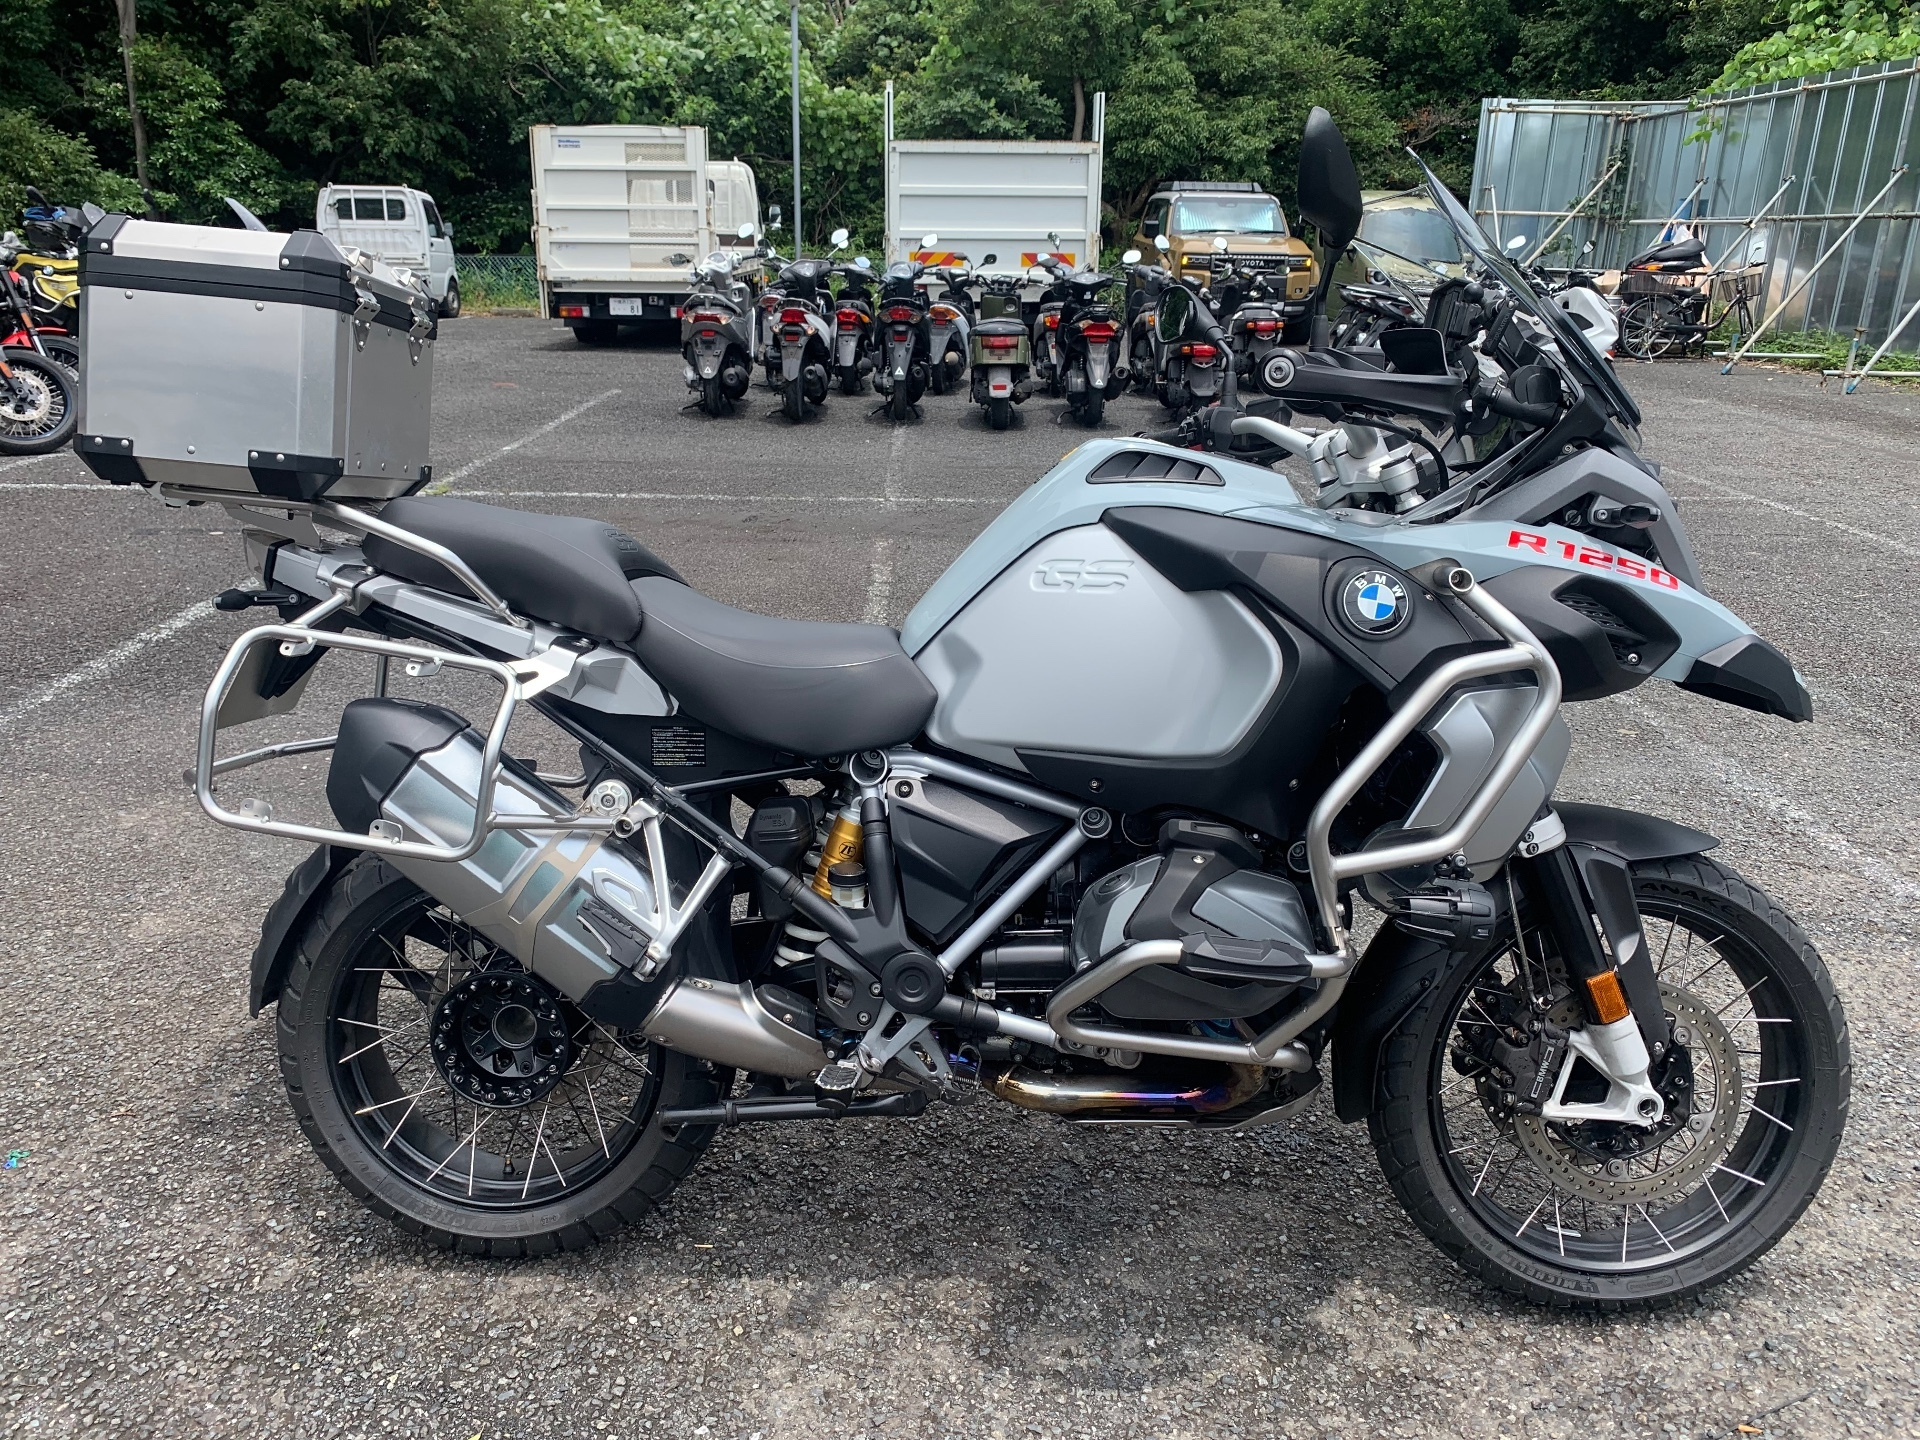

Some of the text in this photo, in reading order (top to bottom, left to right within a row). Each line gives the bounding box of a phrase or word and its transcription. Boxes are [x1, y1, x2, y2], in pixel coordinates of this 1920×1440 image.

[603, 528, 639, 553] GS
[1507, 529, 1680, 592] R 1250
[1029, 558, 1135, 594] GS
[1354, 573, 1405, 598] BMW
[841, 842, 857, 856] ZF
[1536, 1060, 1551, 1083] BMW
[1499, 1252, 1577, 1290] MICHELIN
